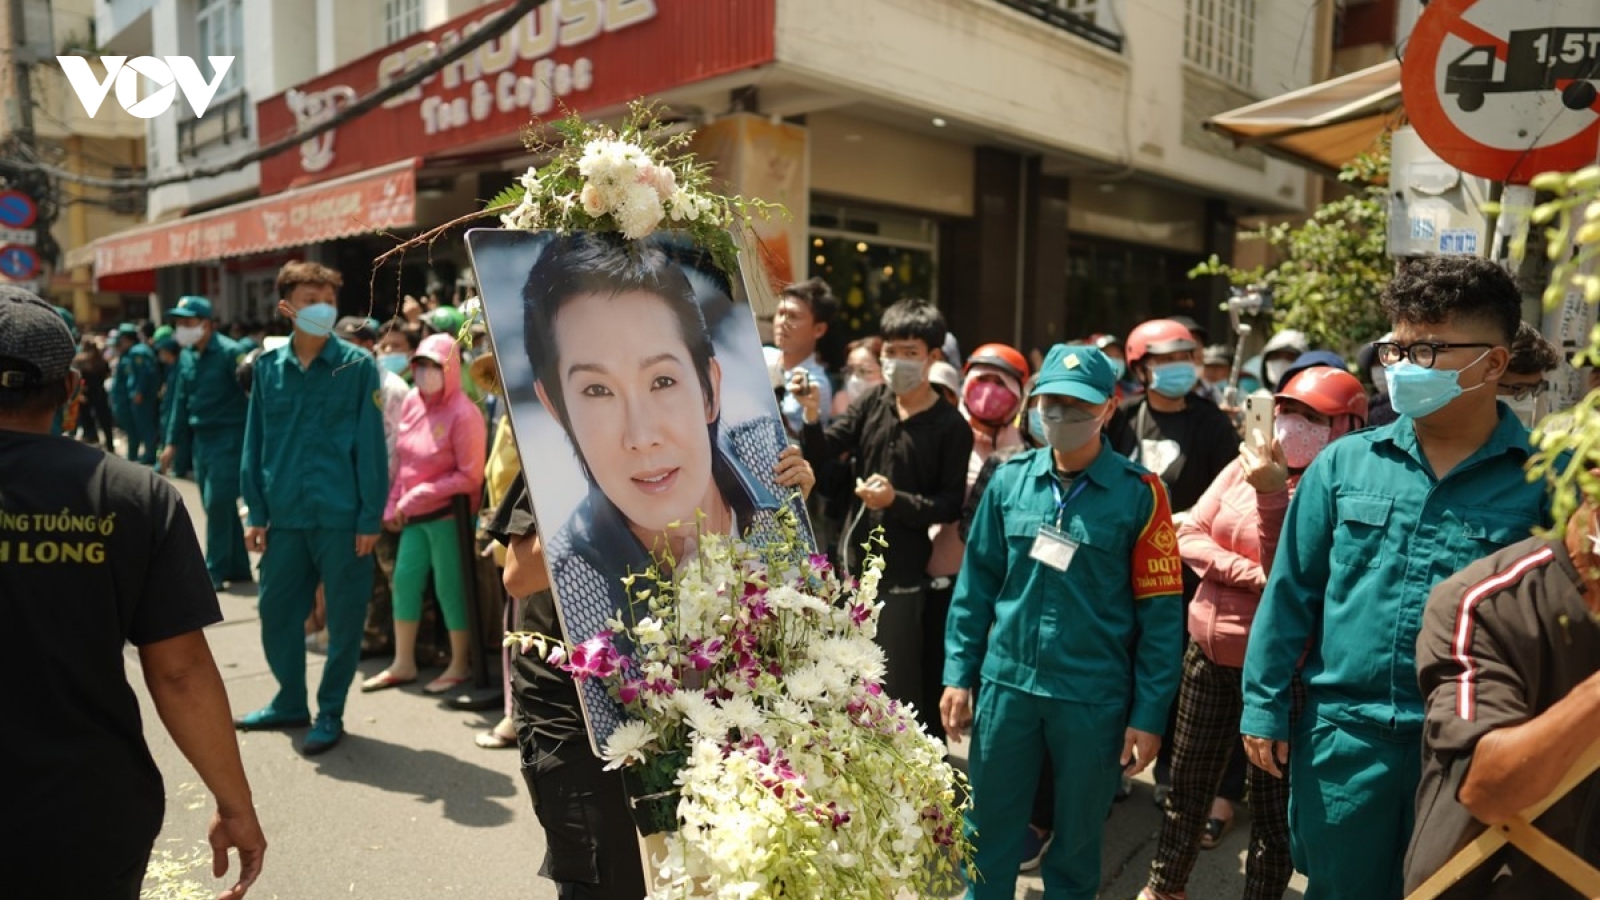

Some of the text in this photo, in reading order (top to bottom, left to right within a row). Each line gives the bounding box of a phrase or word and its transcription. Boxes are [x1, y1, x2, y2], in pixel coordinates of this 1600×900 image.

[1533, 33, 1600, 68] 1,5T
[19, 541, 105, 563] LONG
[1148, 555, 1181, 574] DQT
